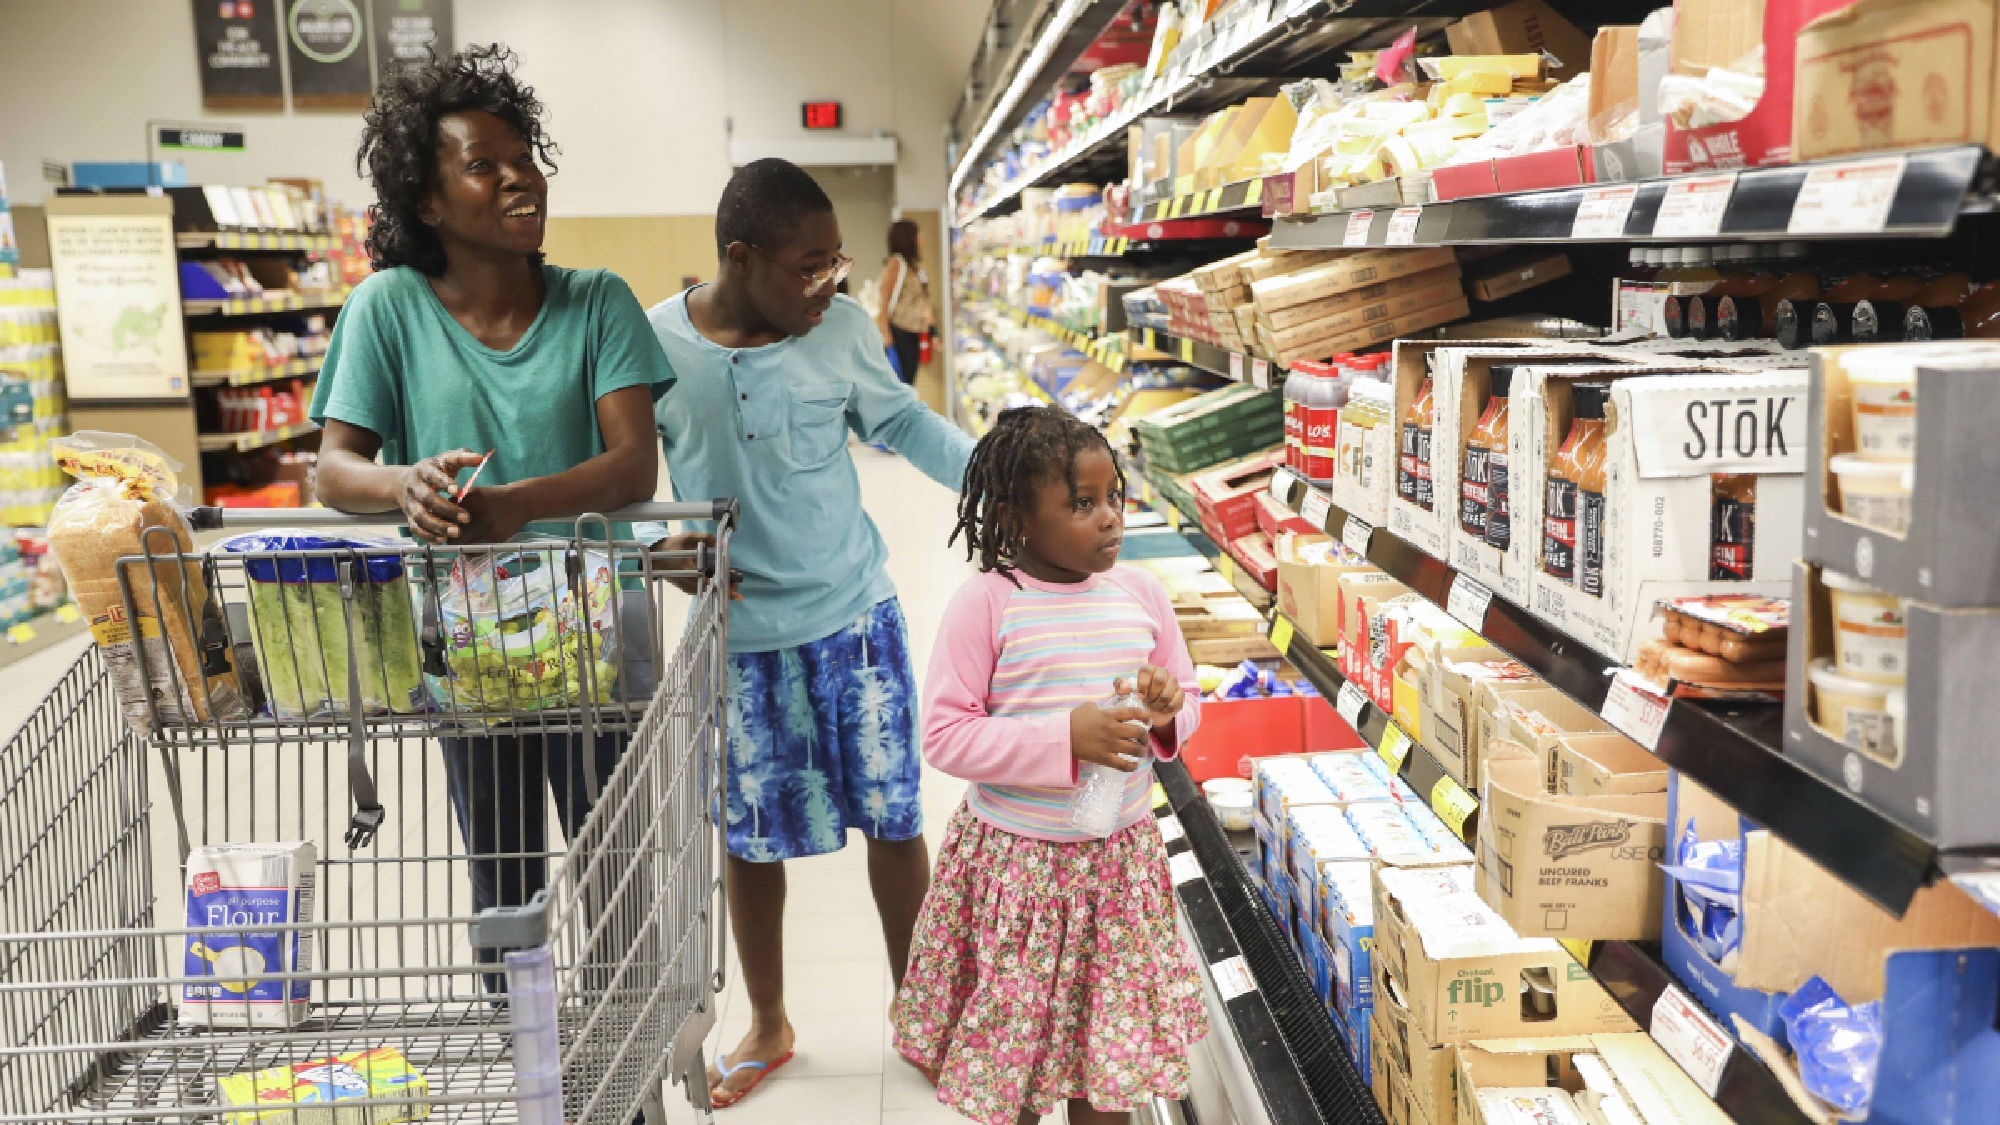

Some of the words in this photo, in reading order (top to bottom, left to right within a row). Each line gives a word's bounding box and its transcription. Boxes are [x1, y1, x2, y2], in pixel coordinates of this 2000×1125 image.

[1539, 867, 1591, 877] UNCURED
[1538, 877, 1563, 887] BEEF
[1565, 877, 1609, 888] FRANKS
[241, 897, 280, 909] purpose
[207, 904, 280, 928] Flour
